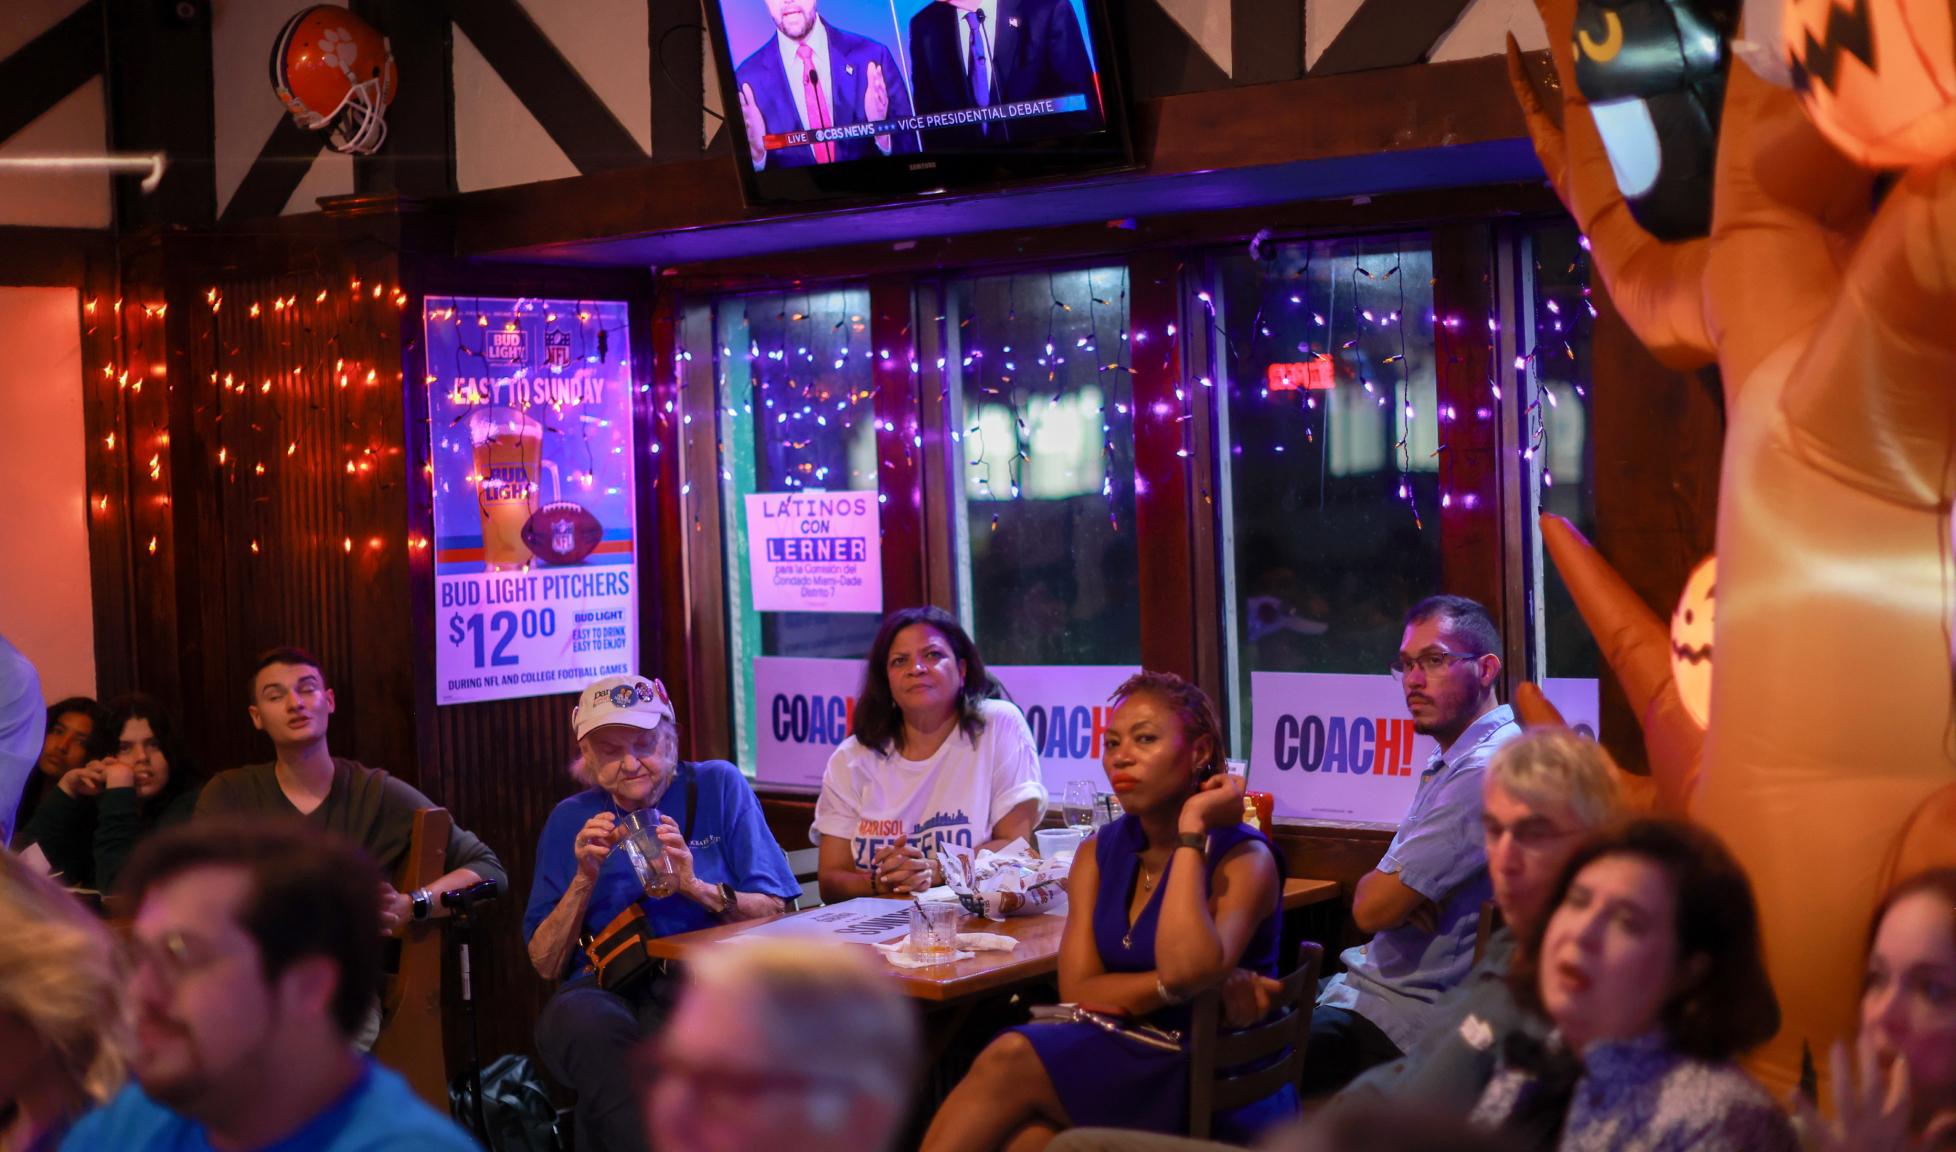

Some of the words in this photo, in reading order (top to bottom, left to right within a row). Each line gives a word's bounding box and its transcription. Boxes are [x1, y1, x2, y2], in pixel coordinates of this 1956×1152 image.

[897, 117, 925, 131] VICE
[927, 108, 1007, 128] PRESIDENTIAL
[1009, 100, 1054, 117] DEBATE
[787, 133, 807, 144] LIVE
[825, 127, 844, 140] CBS
[844, 124, 875, 137] NEWS
[493, 334, 520, 346] BUD
[489, 347, 525, 358] LIGHT
[549, 347, 570, 365] NFL
[454, 377, 500, 405] EASY
[509, 377, 530, 404] TO
[533, 377, 604, 404] SUNDAY
[490, 467, 528, 482] BUD
[486, 483, 530, 500] LIGH
[763, 498, 866, 518] LATINOS
[800, 520, 830, 534] CON
[769, 539, 865, 561] LERNER
[775, 566, 793, 576] para
[795, 564, 803, 573] la
[843, 565, 857, 573] del
[773, 576, 812, 585] Condado
[813, 575, 862, 585] Miami-Dade
[442, 581, 480, 608] BUD
[486, 577, 538, 604] LIGHT
[543, 571, 629, 600] PITCHERS
[801, 587, 829, 597] Distrito
[830, 587, 835, 597] 7
[575, 613, 594, 622] BUD
[595, 611, 622, 621] LIGHT
[573, 629, 590, 640] EASY
[593, 627, 602, 638] TO
[603, 626, 625, 637] DRINK
[573, 641, 590, 652] EASY
[593, 640, 602, 650] TO
[603, 638, 626, 649] ENJOY
[448, 677, 482, 690] DURING
[484, 676, 499, 687] NFL
[501, 674, 519, 685] AND
[521, 671, 556, 683] COLLEGE
[558, 667, 597, 680] FOOTBALL
[599, 664, 628, 676] GAMES
[1026, 705, 1113, 759] OACH
[1274, 713, 1414, 776] COACH!
[859, 819, 904, 836] MARISOL
